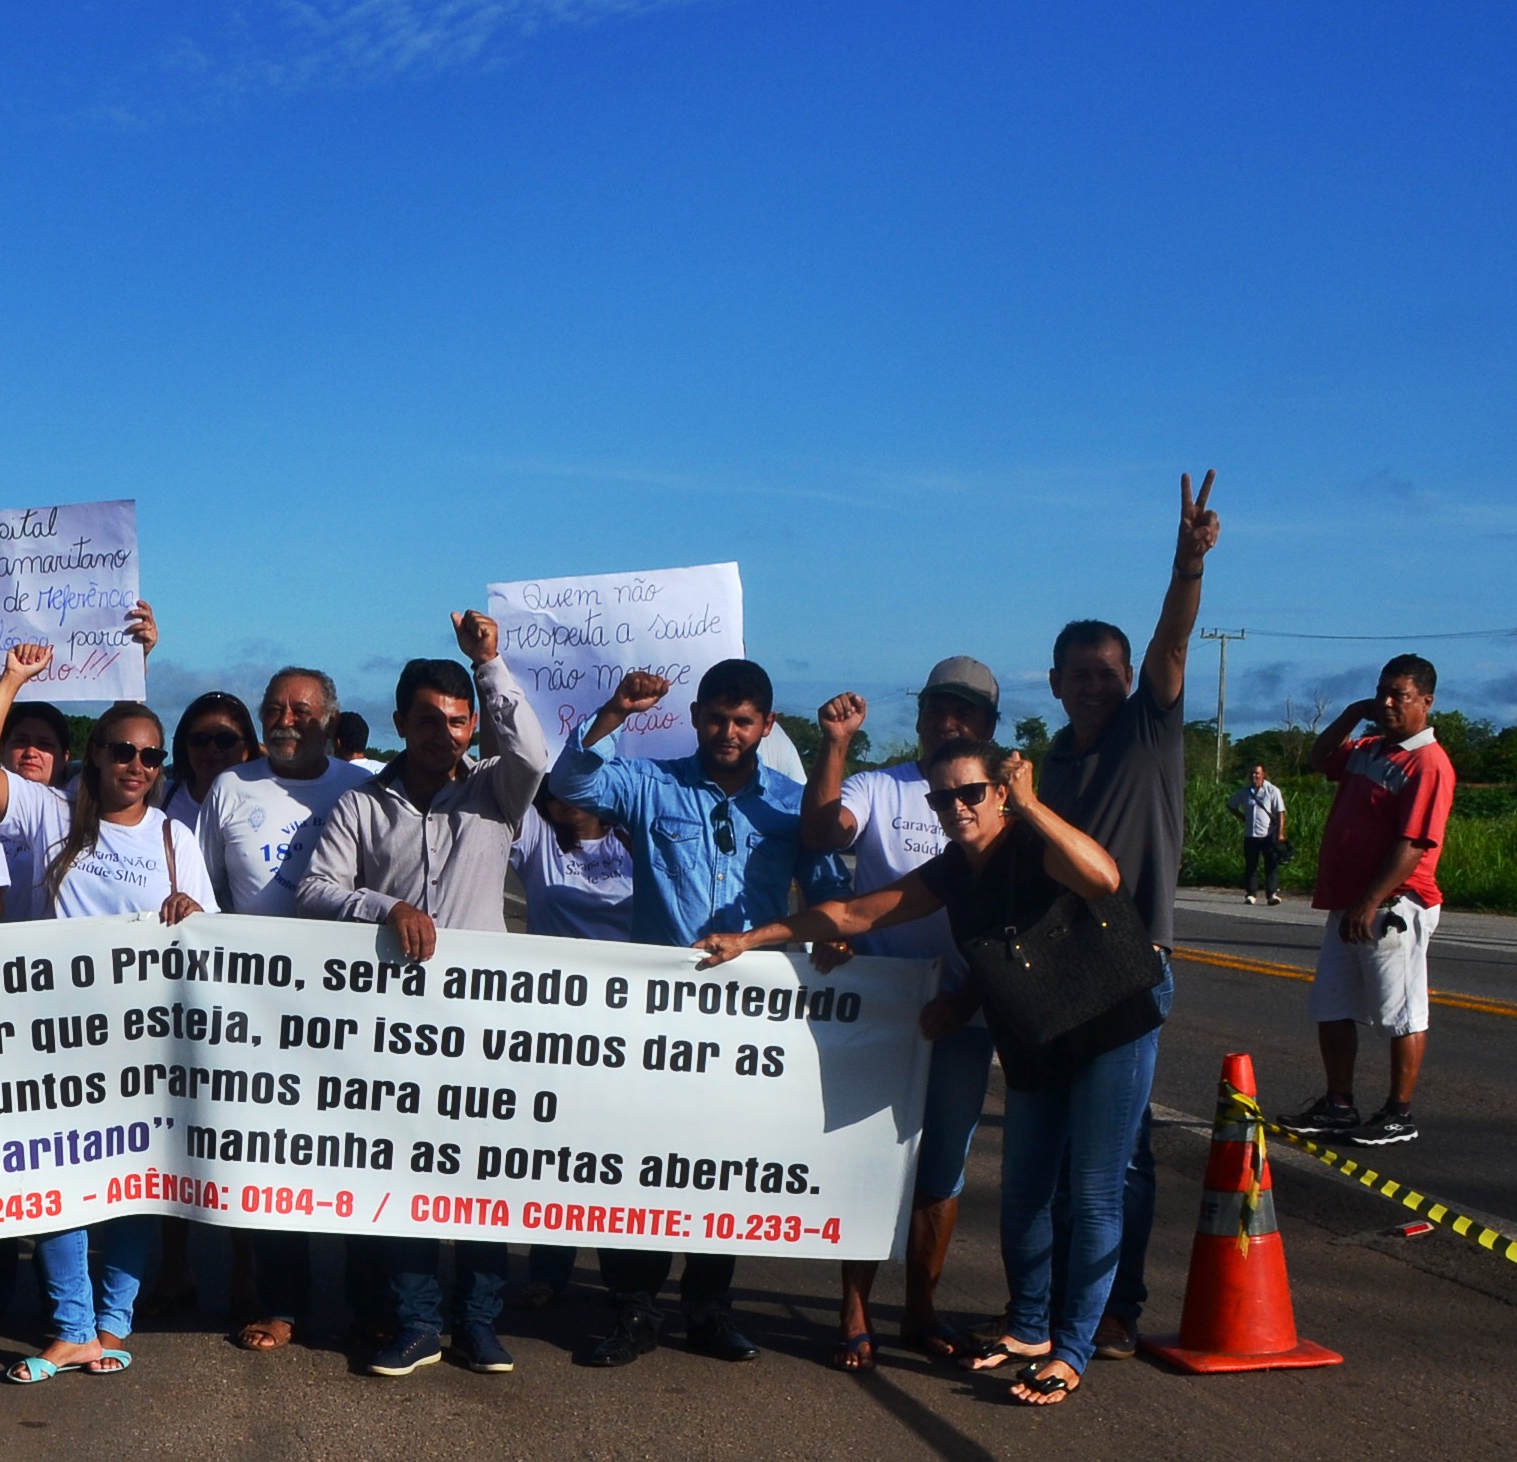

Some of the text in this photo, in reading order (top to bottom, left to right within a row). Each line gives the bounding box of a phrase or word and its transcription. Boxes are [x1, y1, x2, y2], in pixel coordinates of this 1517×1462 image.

[3, 580, 31, 613] de
[36, 581, 135, 627] referência
[523, 578, 664, 610] Quem não
[67, 628, 130, 661] para
[504, 604, 722, 656] respeita a saúde
[528, 661, 586, 691] não
[114, 870, 147, 888] SIM!
[71, 955, 94, 988] o
[112, 940, 305, 991] Próximo,
[443, 967, 587, 1006] amado
[606, 977, 628, 1009] e
[646, 980, 859, 1022] protegido
[31, 1014, 108, 1053] que
[124, 1002, 261, 1047] esteja,
[280, 1015, 358, 1050] por
[374, 1017, 465, 1057] isso
[483, 1029, 626, 1068] vamos
[643, 1035, 720, 1073] dar
[735, 1044, 784, 1077] as
[121, 1064, 300, 1105] orarmos
[317, 1076, 420, 1114] para
[438, 1085, 516, 1120] que
[533, 1091, 557, 1123] o
[187, 1124, 393, 1170] mantenha
[411, 1141, 461, 1174] as
[477, 1146, 623, 1185] portas
[639, 1153, 819, 1194] abertas.
[108, 1168, 228, 1210] AGÊNCIA:
[242, 1186, 353, 1217] 0184-8
[373, 1193, 390, 1222] /
[411, 1195, 509, 1226] CONTA
[523, 1202, 691, 1236] CORRENTE:
[703, 1213, 840, 1243] 10.233-4
